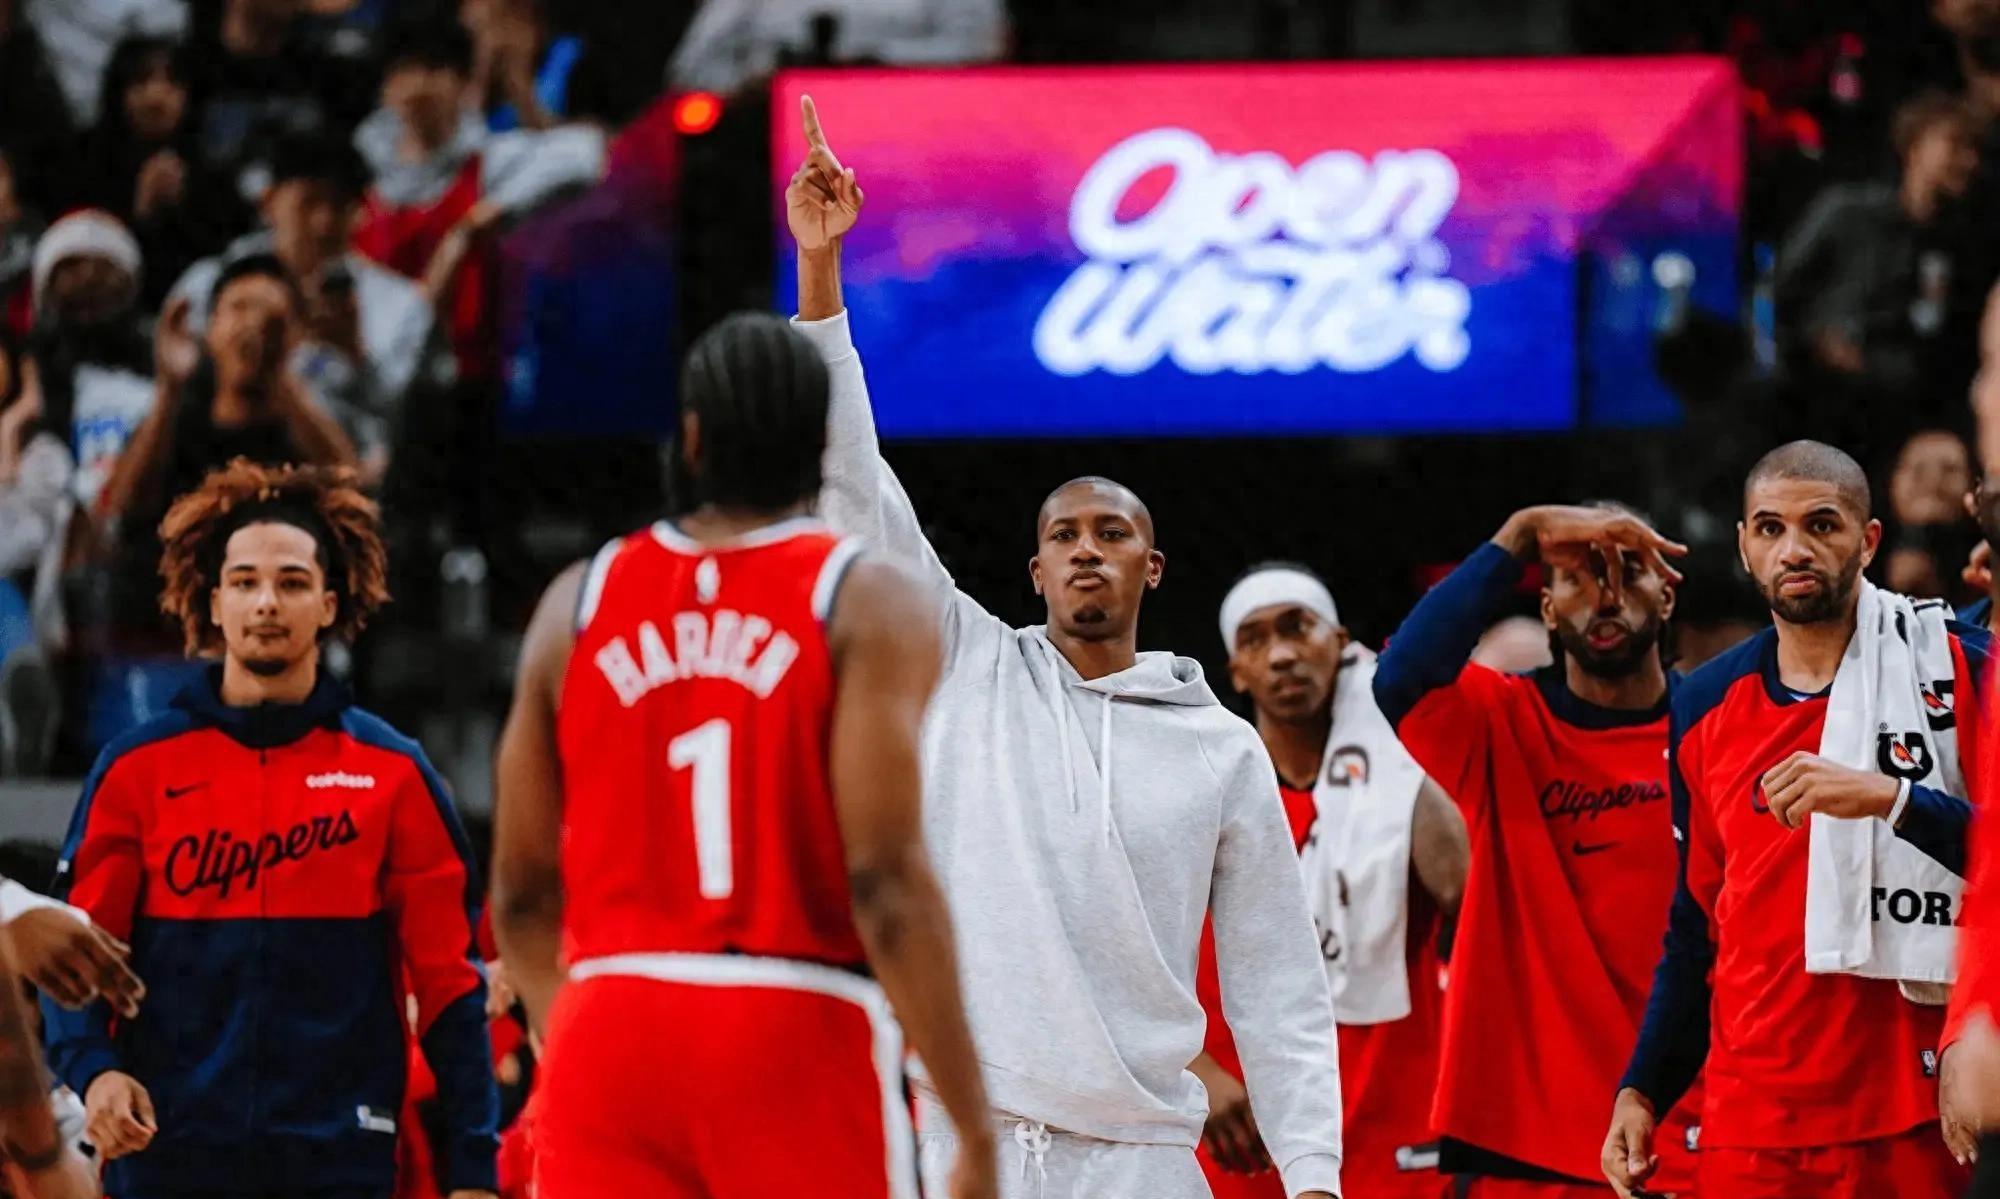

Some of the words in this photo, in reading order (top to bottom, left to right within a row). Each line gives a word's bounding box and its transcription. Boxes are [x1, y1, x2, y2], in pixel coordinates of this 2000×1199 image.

[1069, 127, 1460, 262] Open
[1033, 243, 1472, 376] Water
[594, 608, 800, 708] HARDEN
[165, 808, 360, 898] Clippers
[667, 717, 733, 900] 1
[1539, 780, 1666, 821] Clippers
